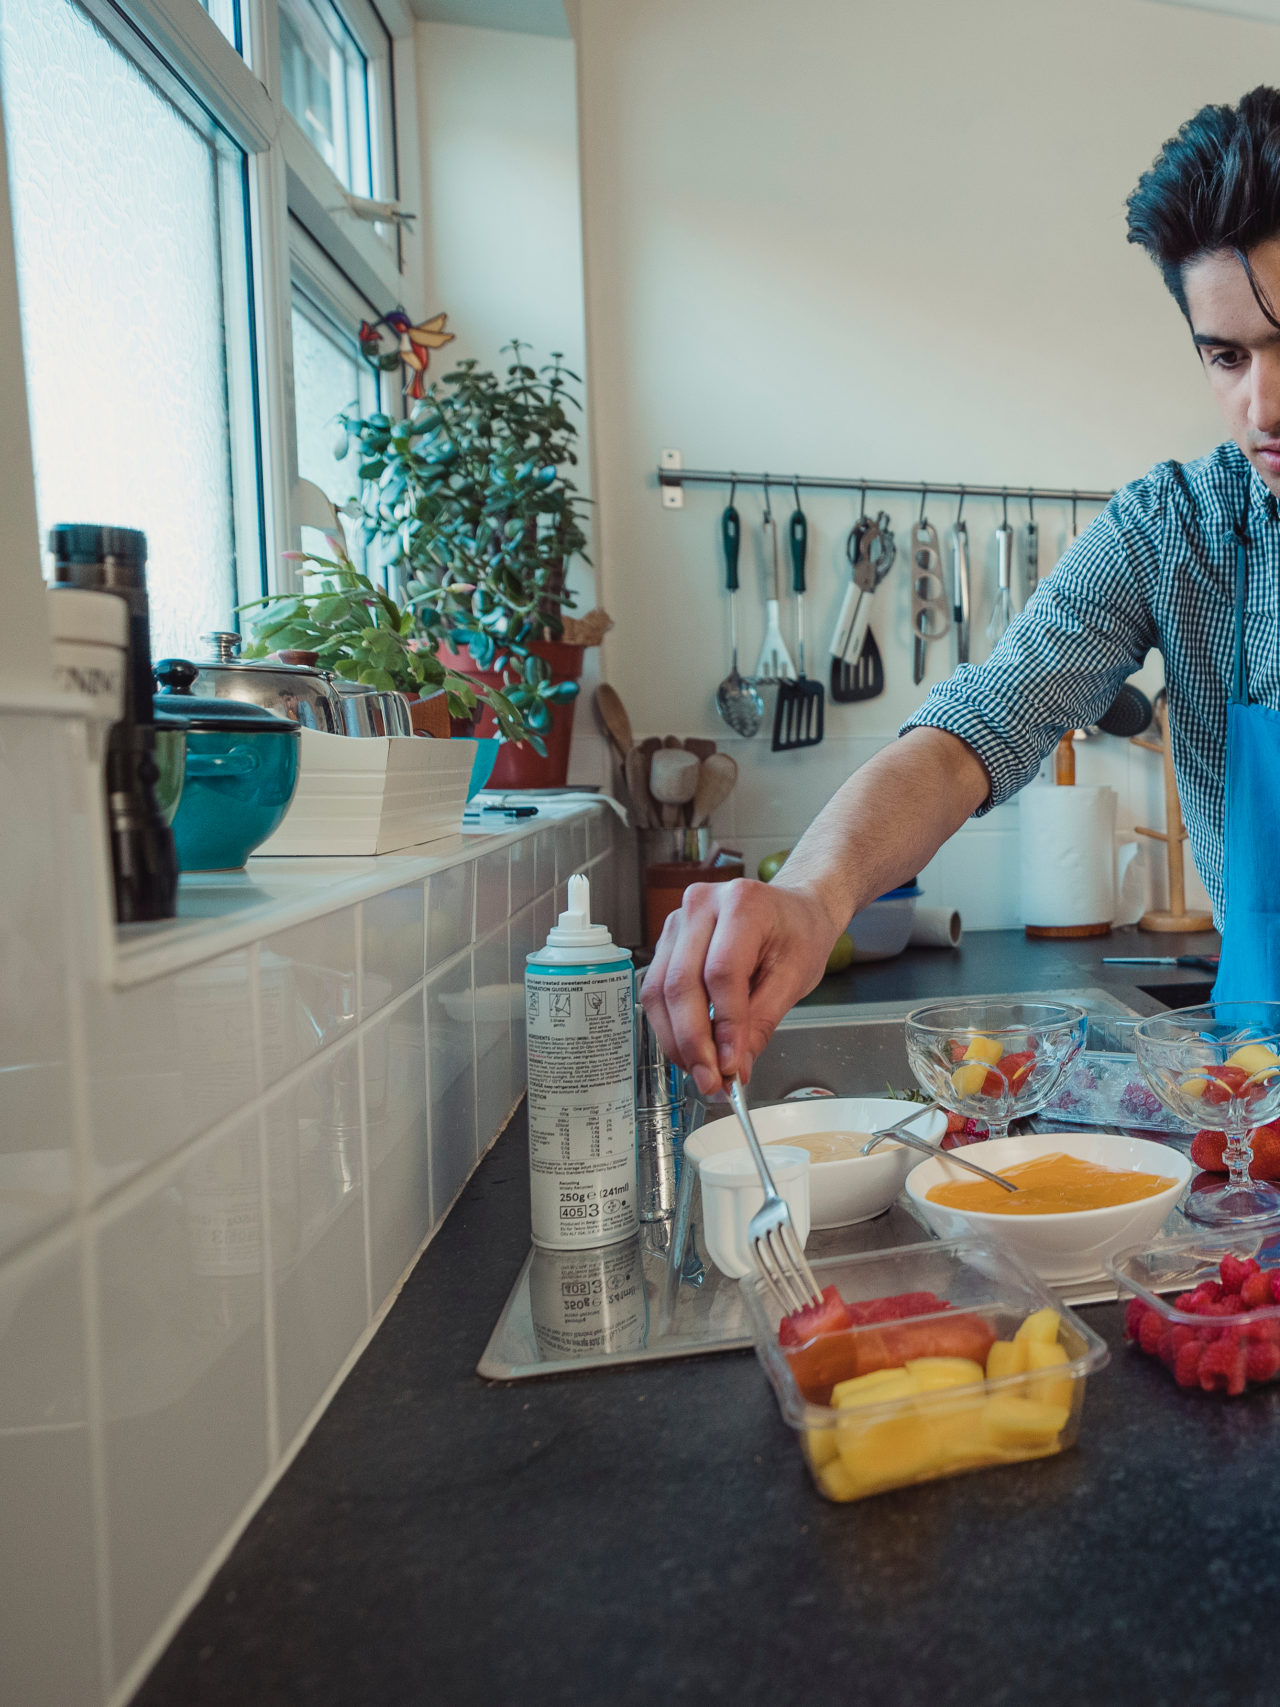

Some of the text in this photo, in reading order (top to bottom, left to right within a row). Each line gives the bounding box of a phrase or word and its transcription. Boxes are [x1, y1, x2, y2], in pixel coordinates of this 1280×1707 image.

[560, 1193, 586, 1203] 250g
[600, 1182, 630, 1198] (241ml)
[562, 1208, 584, 1217] 405
[588, 1203, 600, 1218] 3
